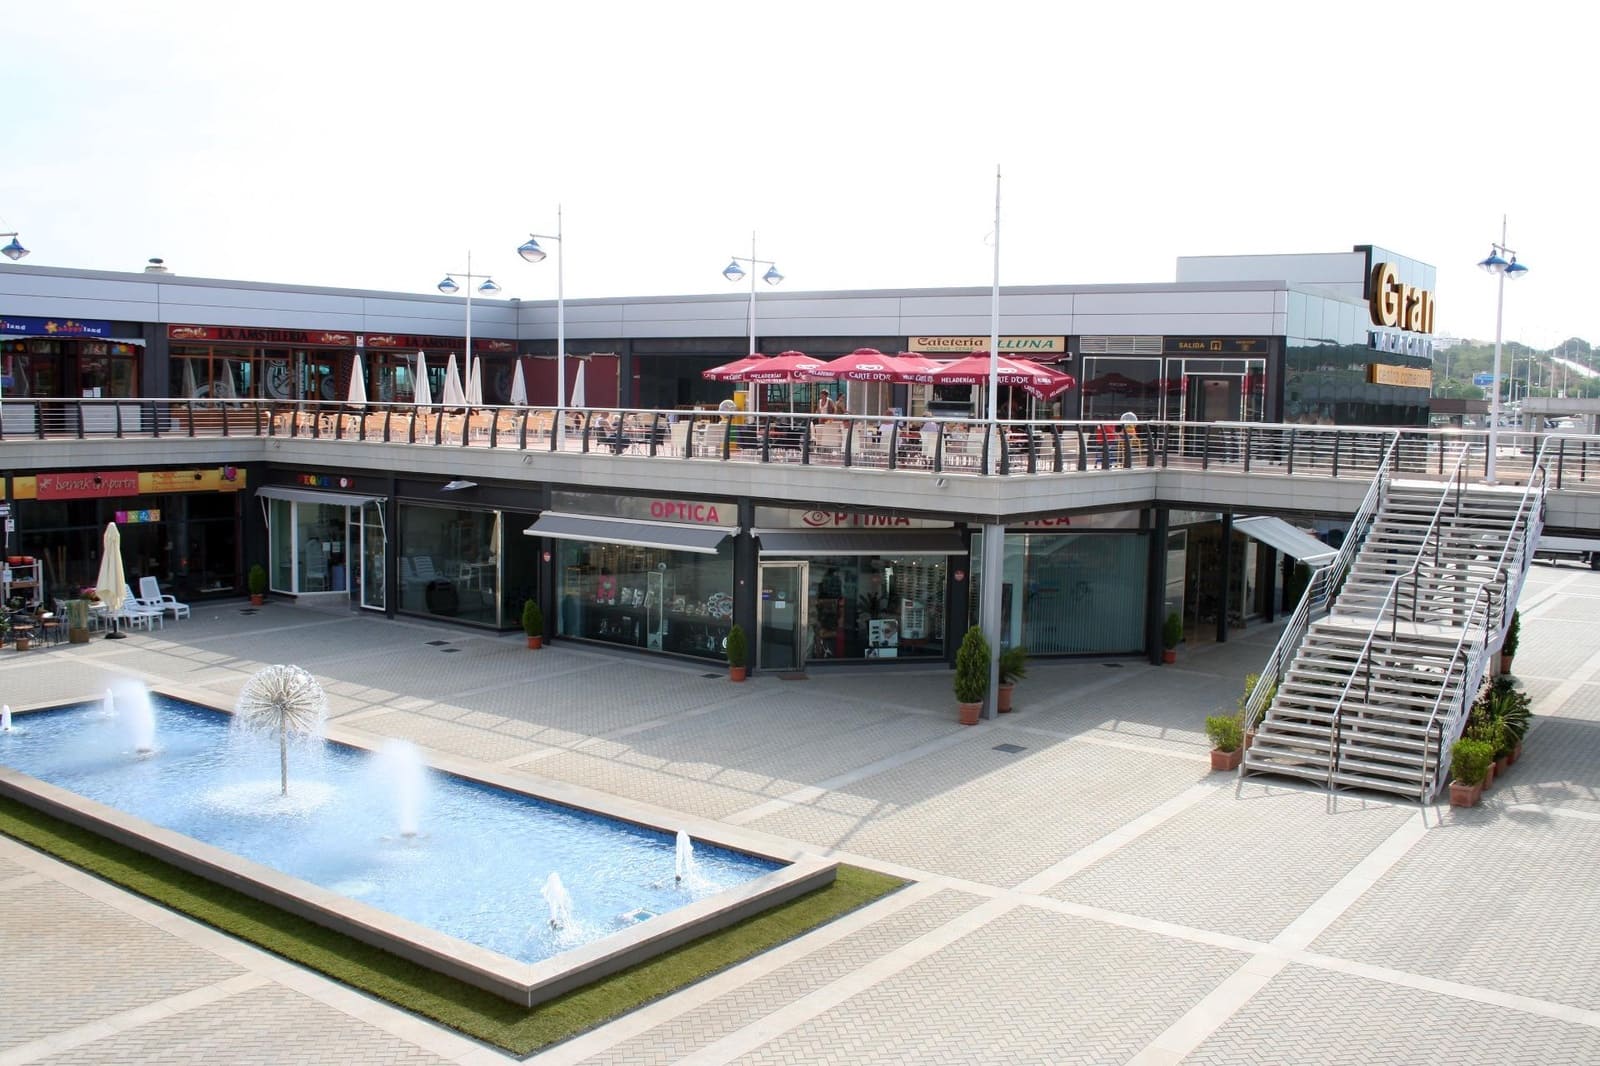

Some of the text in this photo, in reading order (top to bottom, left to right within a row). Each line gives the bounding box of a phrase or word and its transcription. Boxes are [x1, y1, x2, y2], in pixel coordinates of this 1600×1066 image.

[1371, 262, 1435, 334] Gran
[1178, 341, 1205, 350] SALIDA
[848, 371, 870, 380] CARTE
[650, 501, 720, 523] OPTICA
